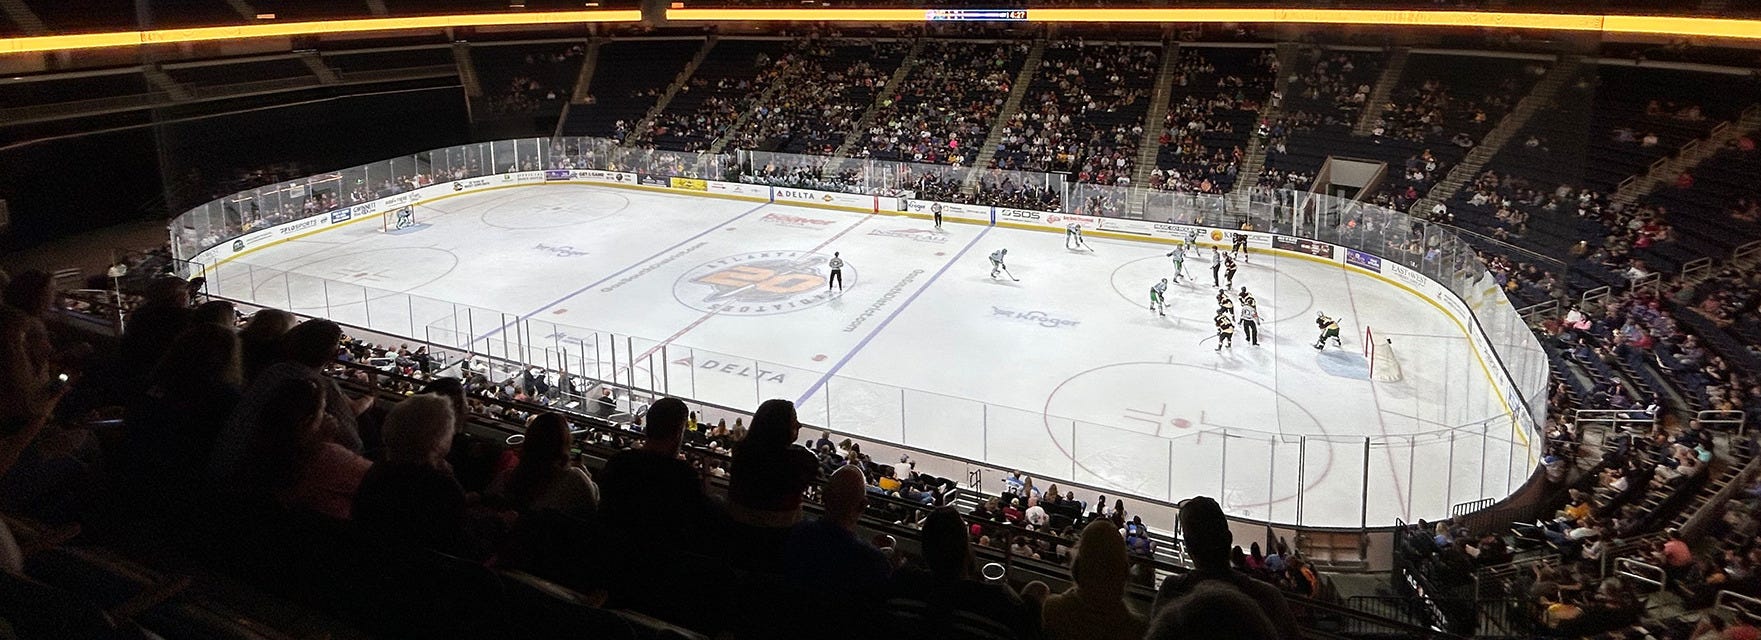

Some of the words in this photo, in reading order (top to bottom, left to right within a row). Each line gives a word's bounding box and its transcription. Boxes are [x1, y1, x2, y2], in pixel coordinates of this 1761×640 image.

[785, 190, 815, 200] DELTA
[1012, 209, 1041, 220] SOS
[1015, 310, 1081, 328] Kroger
[700, 359, 786, 384] DELTA
